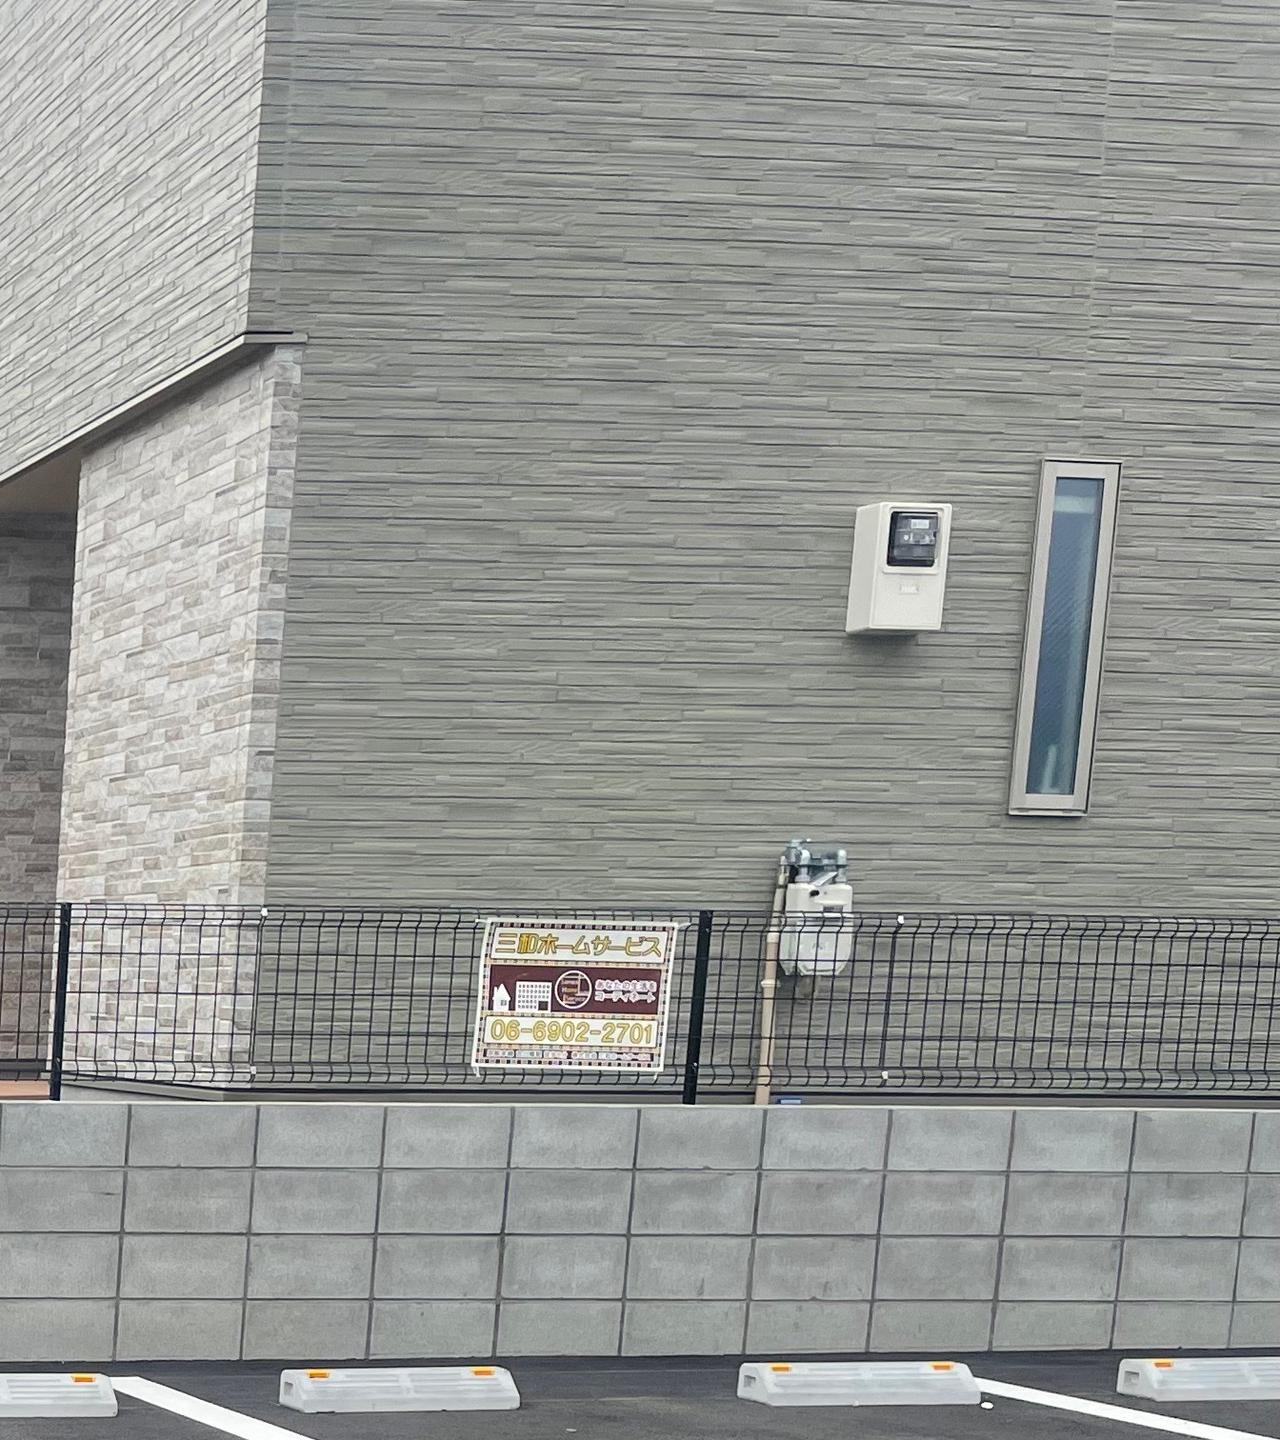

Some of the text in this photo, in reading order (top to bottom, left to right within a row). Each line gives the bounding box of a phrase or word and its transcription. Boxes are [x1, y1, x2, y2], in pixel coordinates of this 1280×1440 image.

[495, 932, 662, 958] 三和ホームサービス
[491, 1018, 654, 1045] 06-6902-2701
